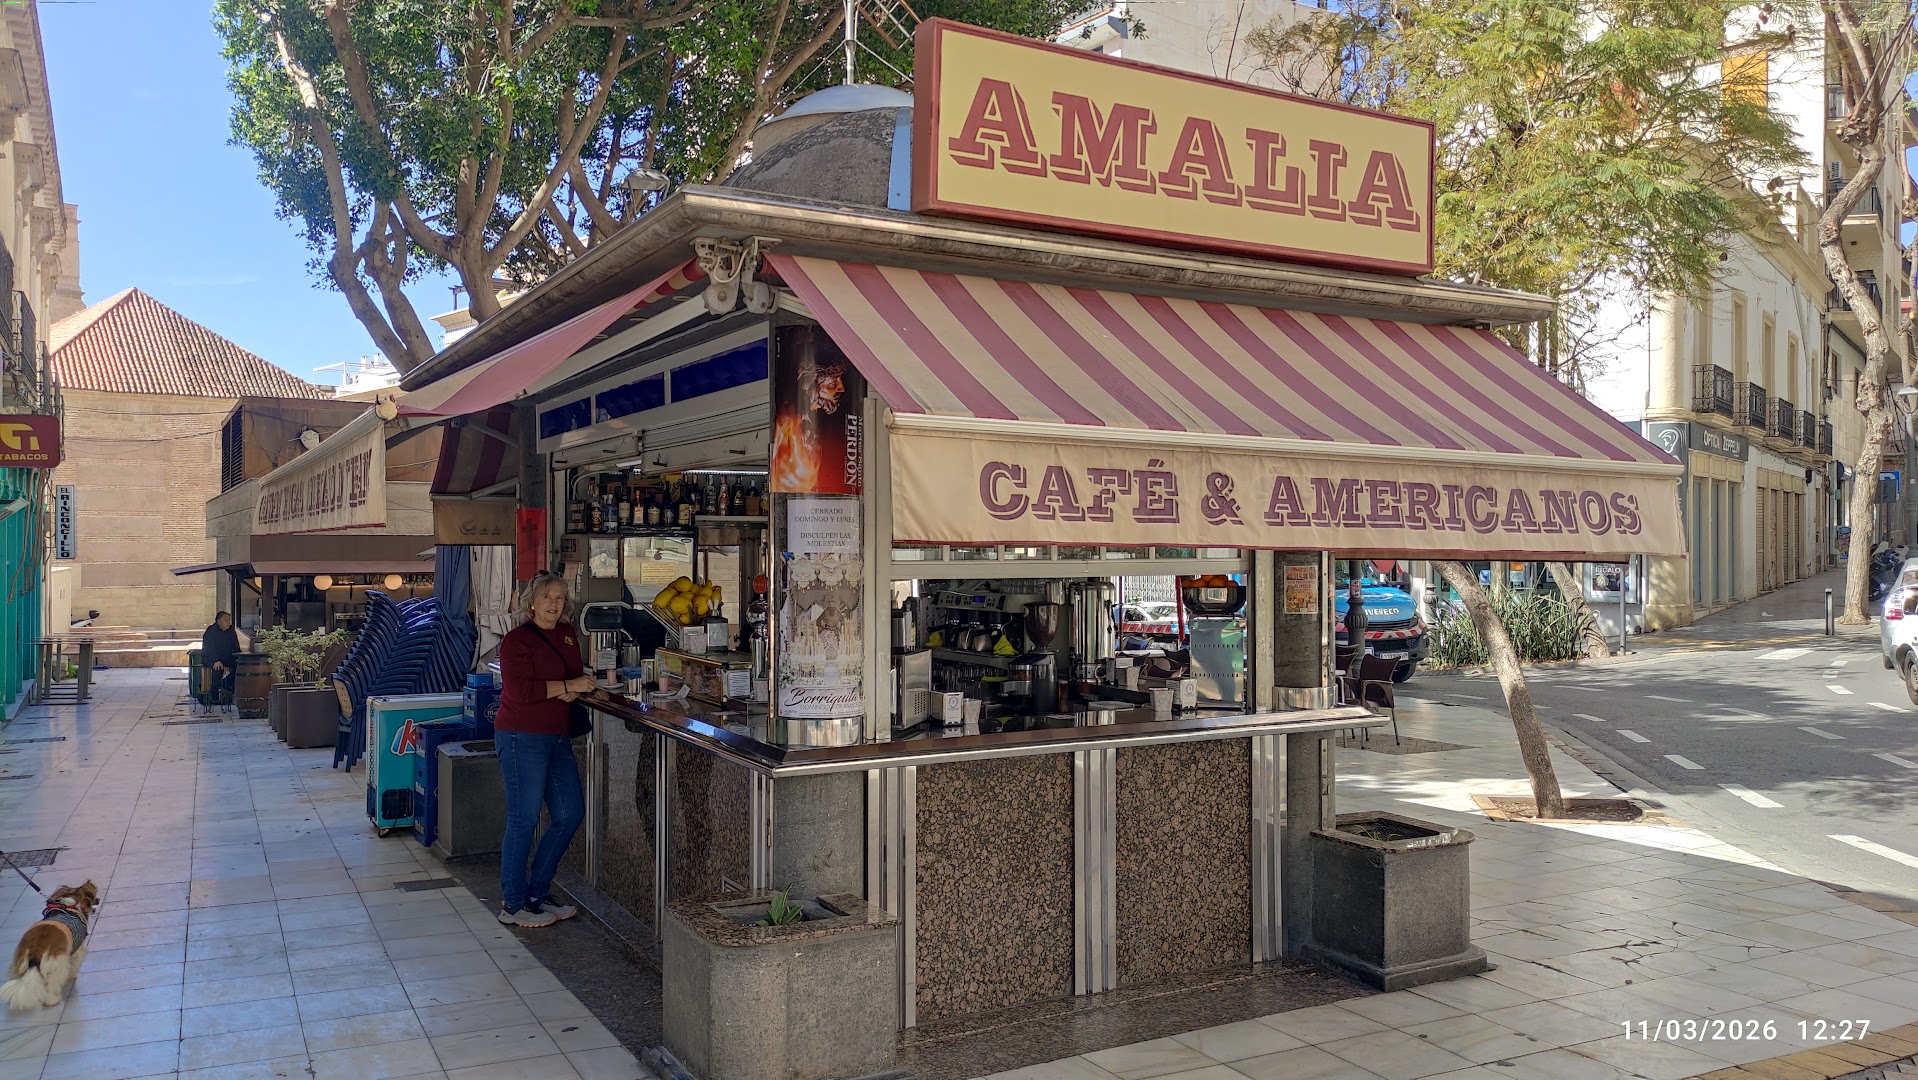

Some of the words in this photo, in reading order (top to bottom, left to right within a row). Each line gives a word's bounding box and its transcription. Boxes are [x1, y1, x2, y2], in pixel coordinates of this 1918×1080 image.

[948, 77, 1421, 233] AMALIA
[1722, 436, 1740, 453] ZEPPELIN
[810, 507, 843, 515] CERRADO
[979, 458, 1180, 524] CAFÉ
[1200, 472, 1244, 526] &
[1263, 475, 1642, 535] AMERICANOS
[60, 494, 70, 558] RINCONCILLO
[784, 686, 857, 712] Borriquita
